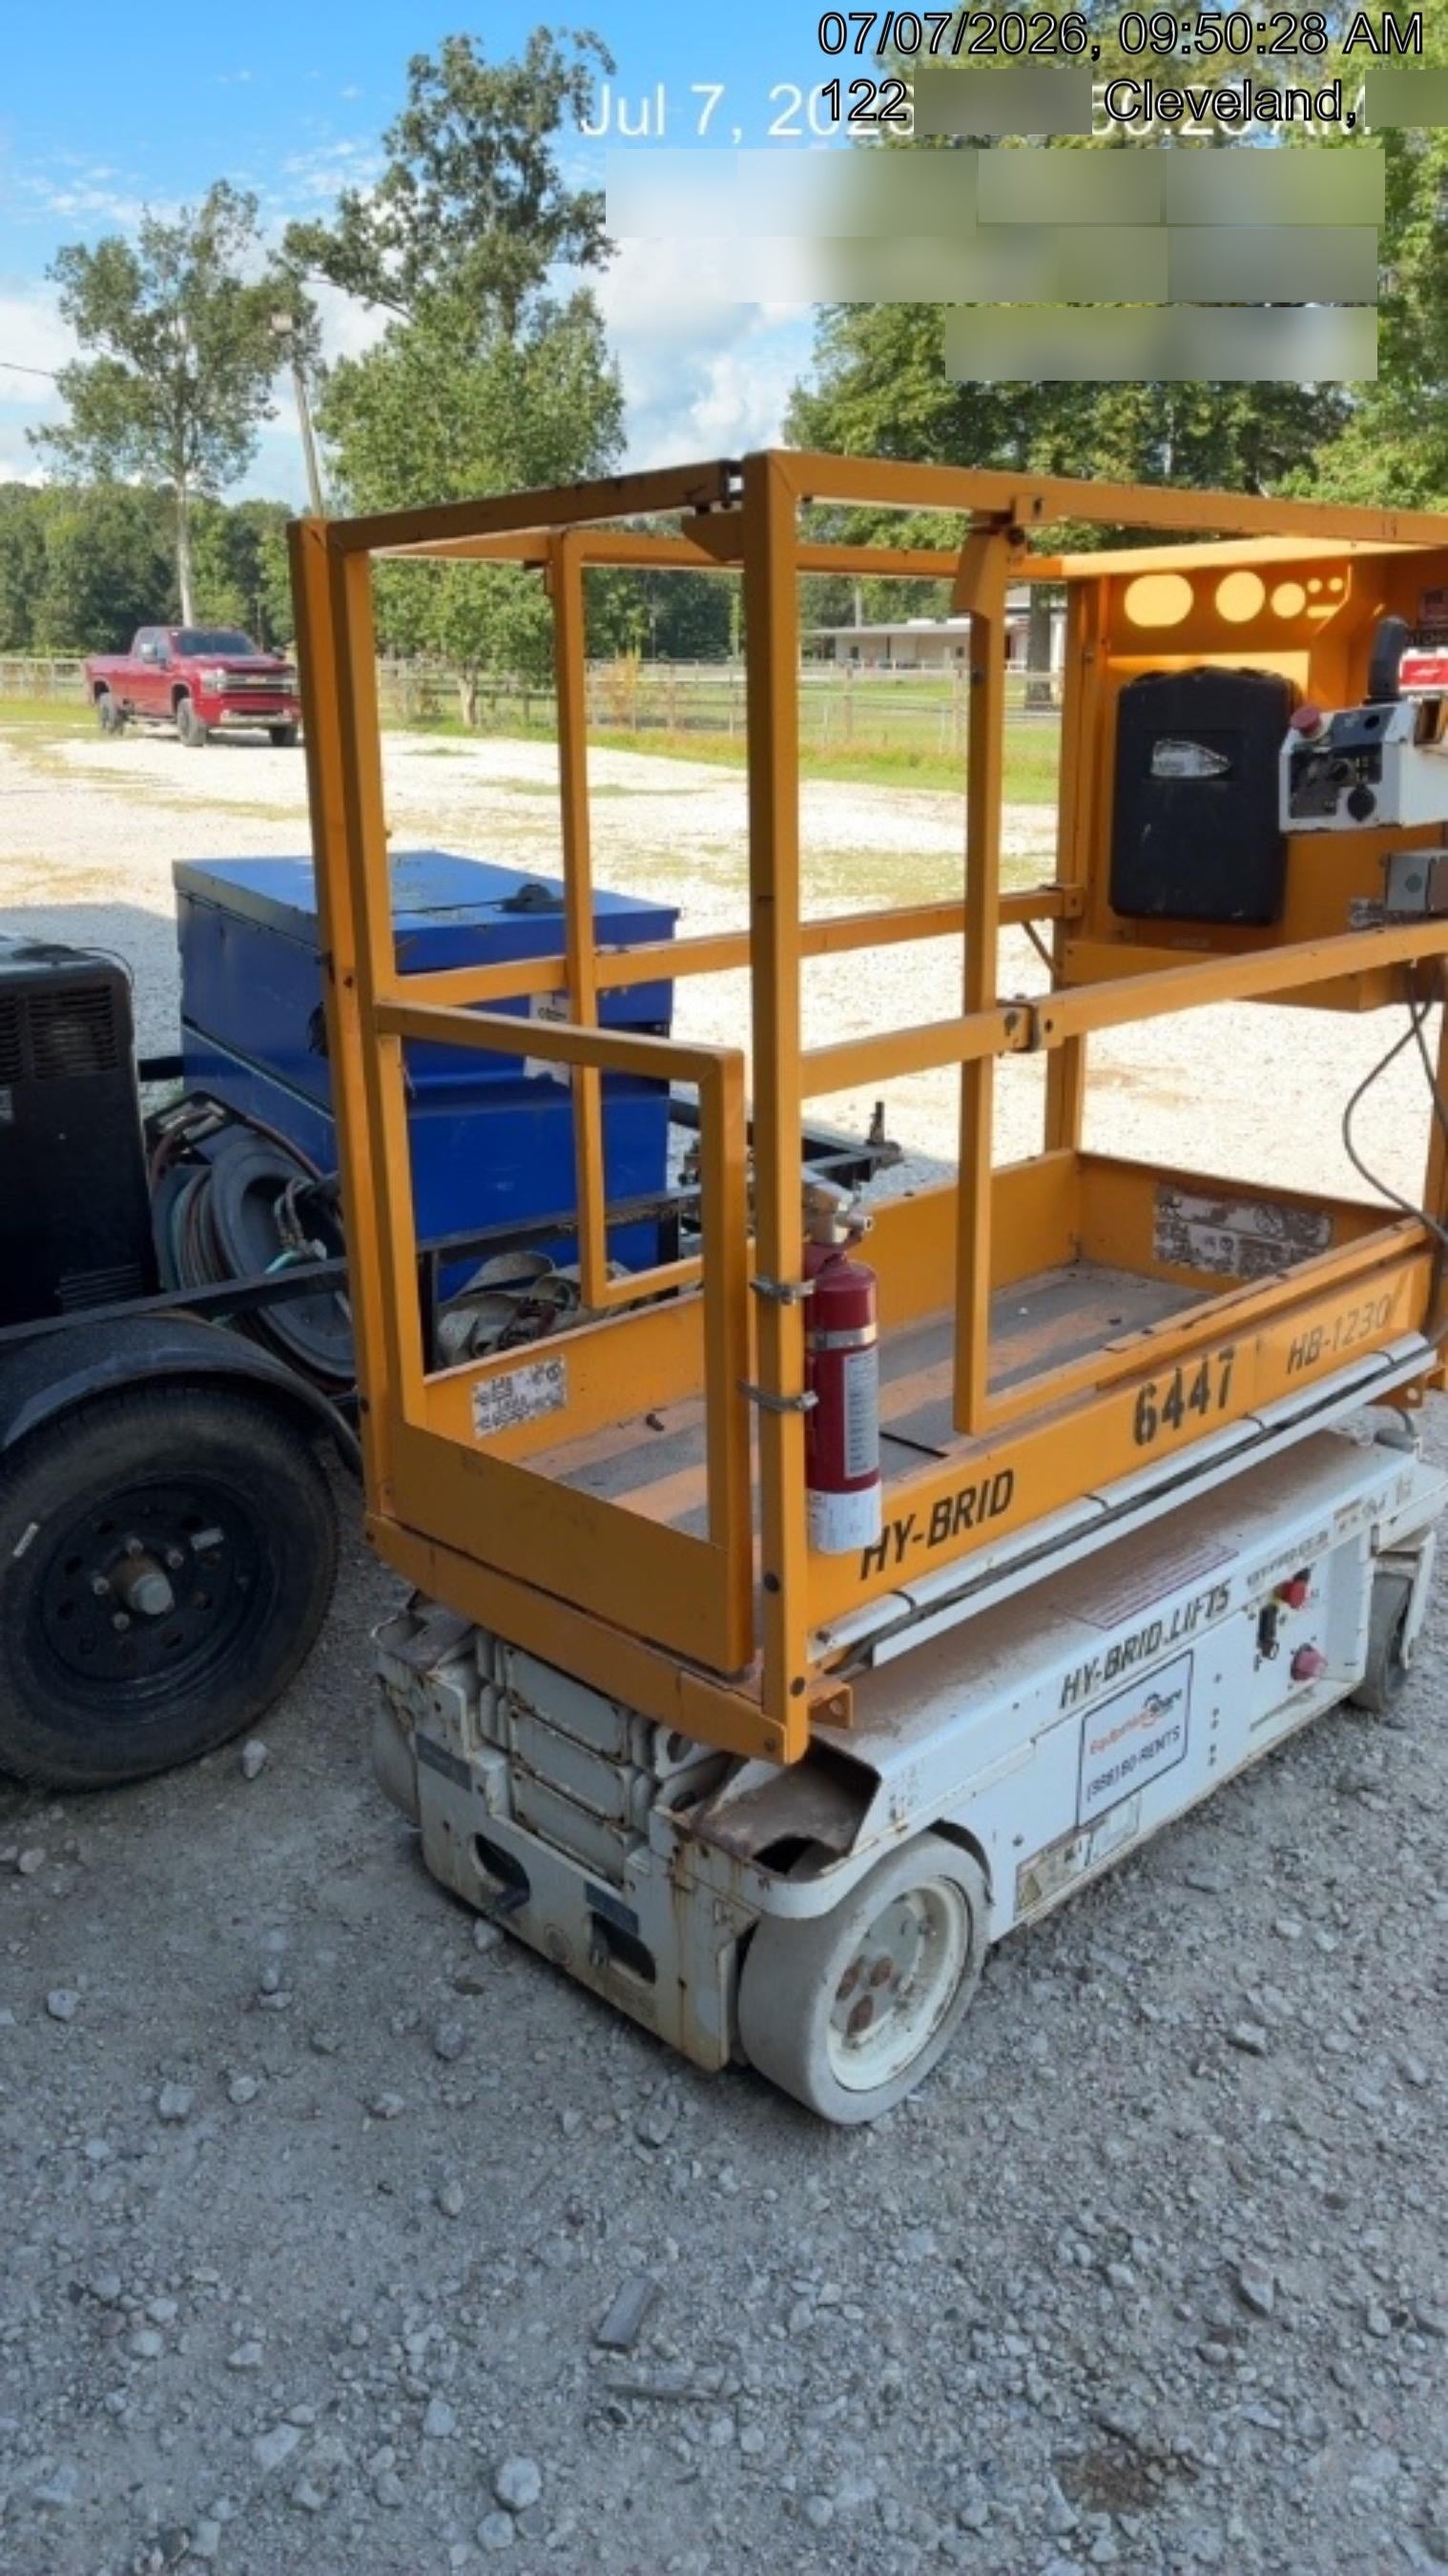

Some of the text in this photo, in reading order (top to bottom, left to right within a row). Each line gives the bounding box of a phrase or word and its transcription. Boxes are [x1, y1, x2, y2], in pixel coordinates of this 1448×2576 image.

[1287, 1294, 1392, 1375] HB-1230
[1133, 1344, 1236, 1446] 6447
[860, 1468, 1014, 1581] HY-BRID
